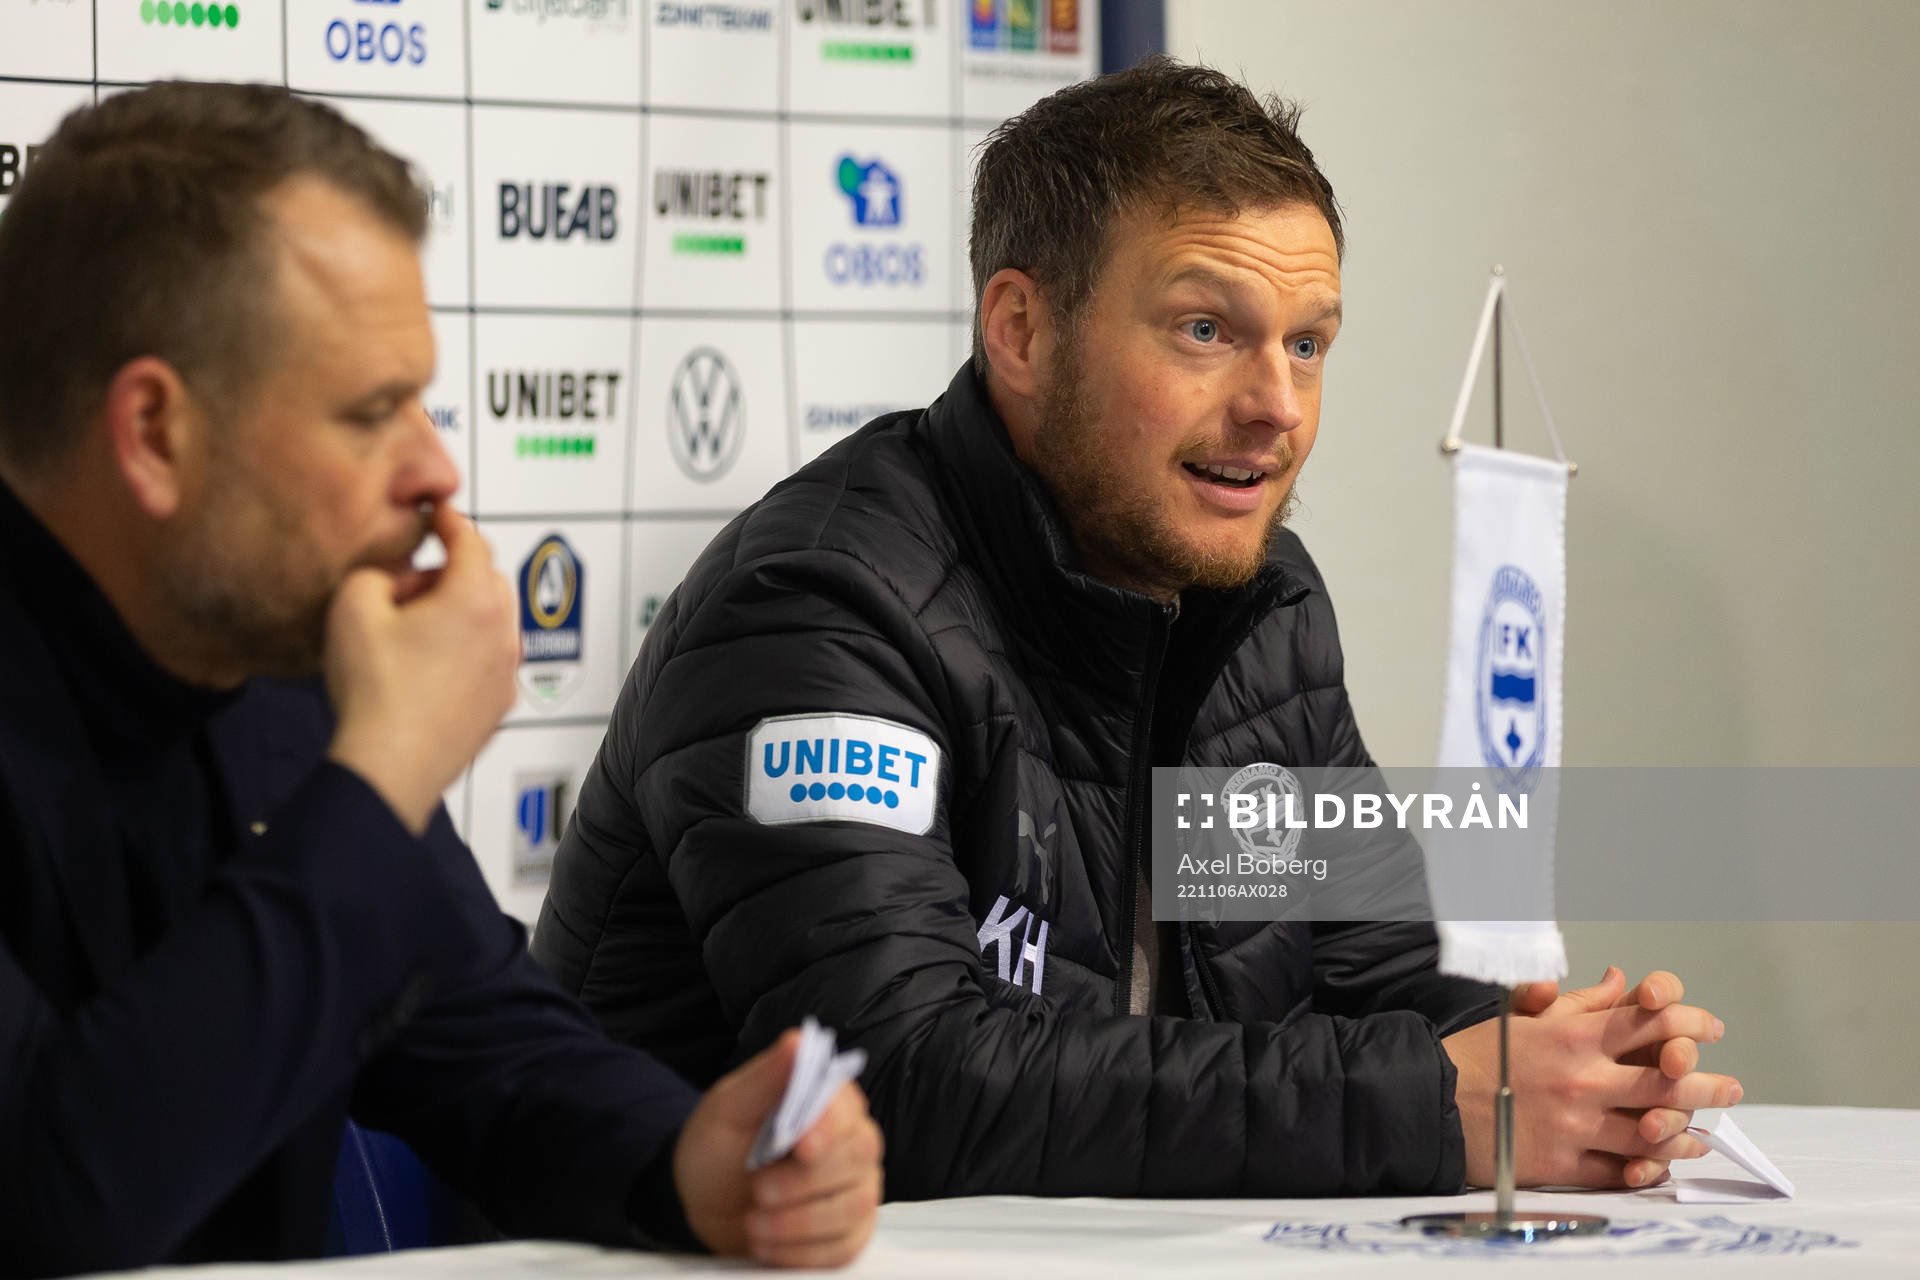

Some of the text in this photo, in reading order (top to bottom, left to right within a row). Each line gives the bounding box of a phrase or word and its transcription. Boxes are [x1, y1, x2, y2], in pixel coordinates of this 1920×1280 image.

[325, 18, 427, 66] OBOS
[498, 182, 618, 241] BUFAB
[654, 168, 770, 220] UNIBET
[824, 244, 924, 287] OBOS
[488, 369, 621, 425] UNIBET
[764, 737, 928, 789] UNIBET
[977, 894, 1049, 996] KH
